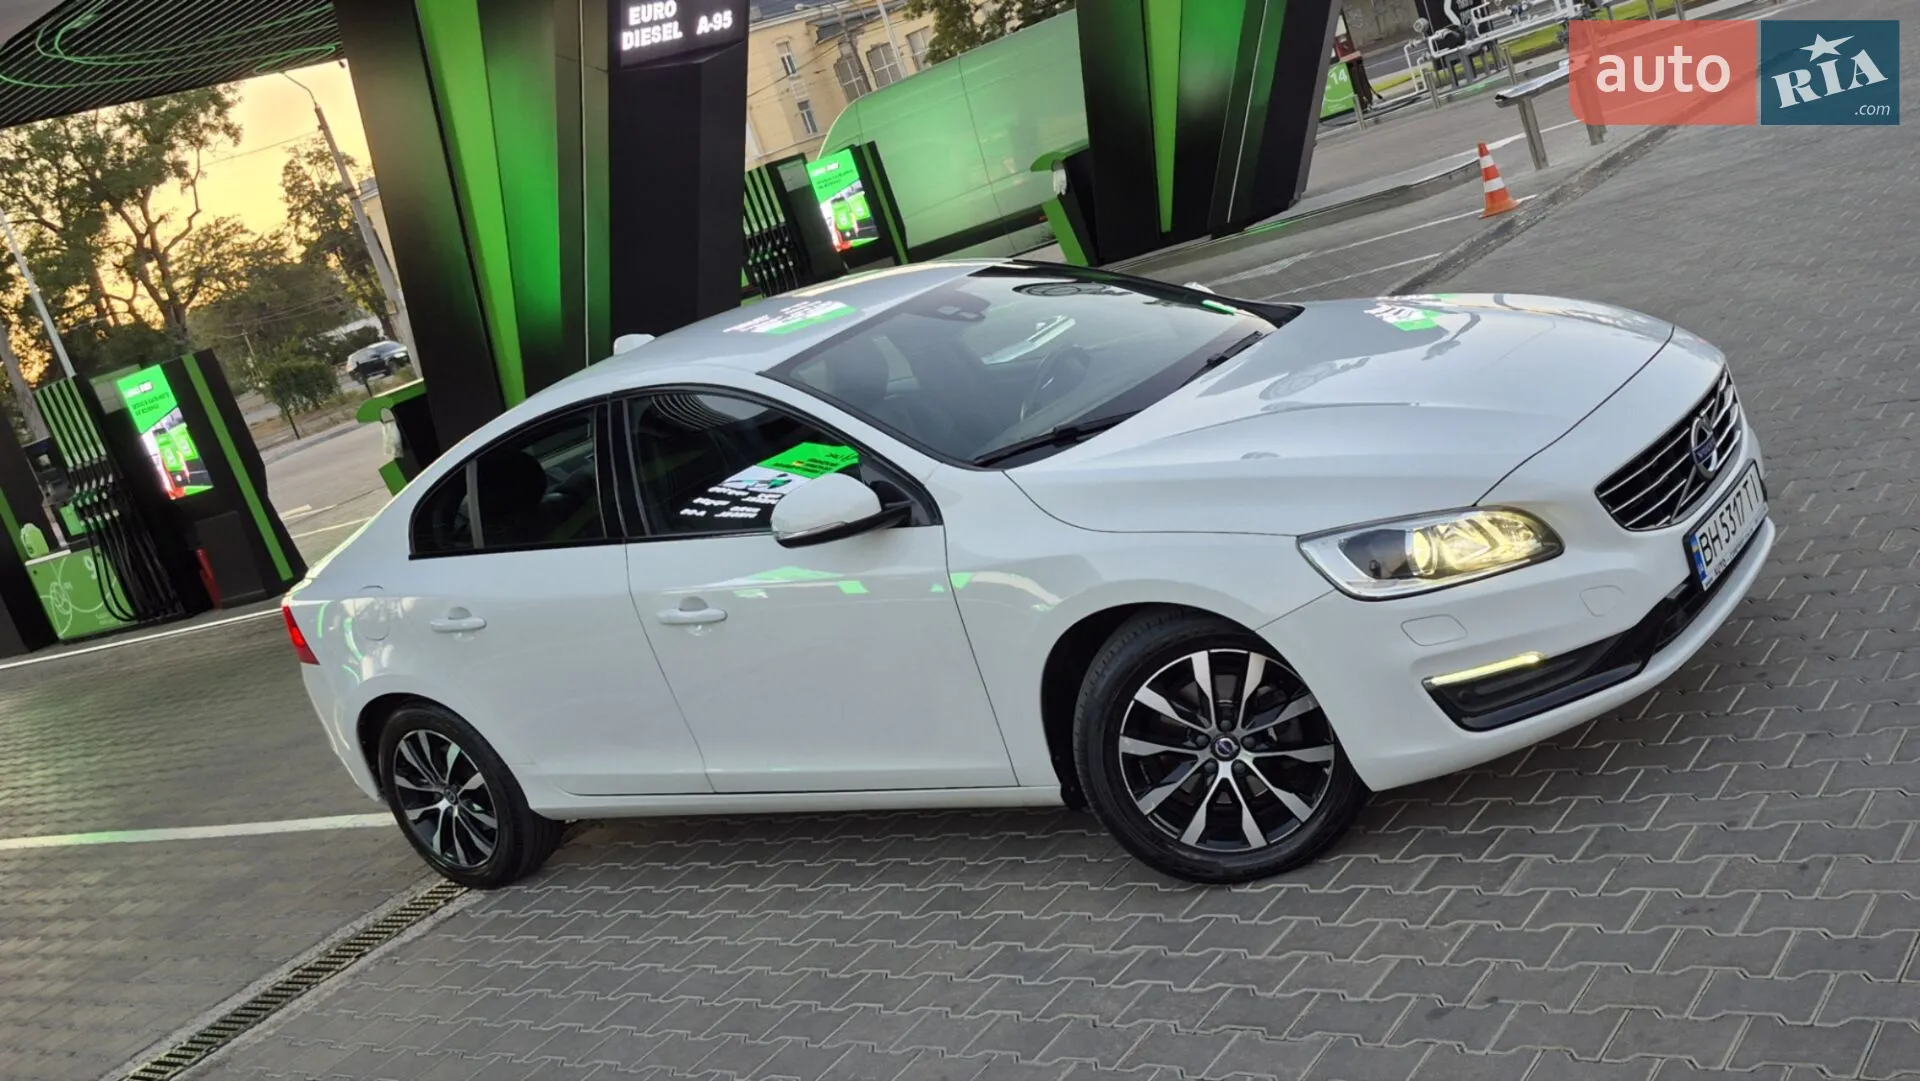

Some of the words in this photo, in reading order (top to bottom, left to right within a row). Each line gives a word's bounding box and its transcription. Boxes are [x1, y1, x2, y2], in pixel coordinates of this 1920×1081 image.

[628, 0, 677, 26] EURO
[696, 9, 733, 35] A-95
[621, 21, 683, 51] DIESEL
[1329, 68, 1348, 85] 14
[1699, 525, 1723, 567] BH
[1720, 493, 1745, 543] 5317
